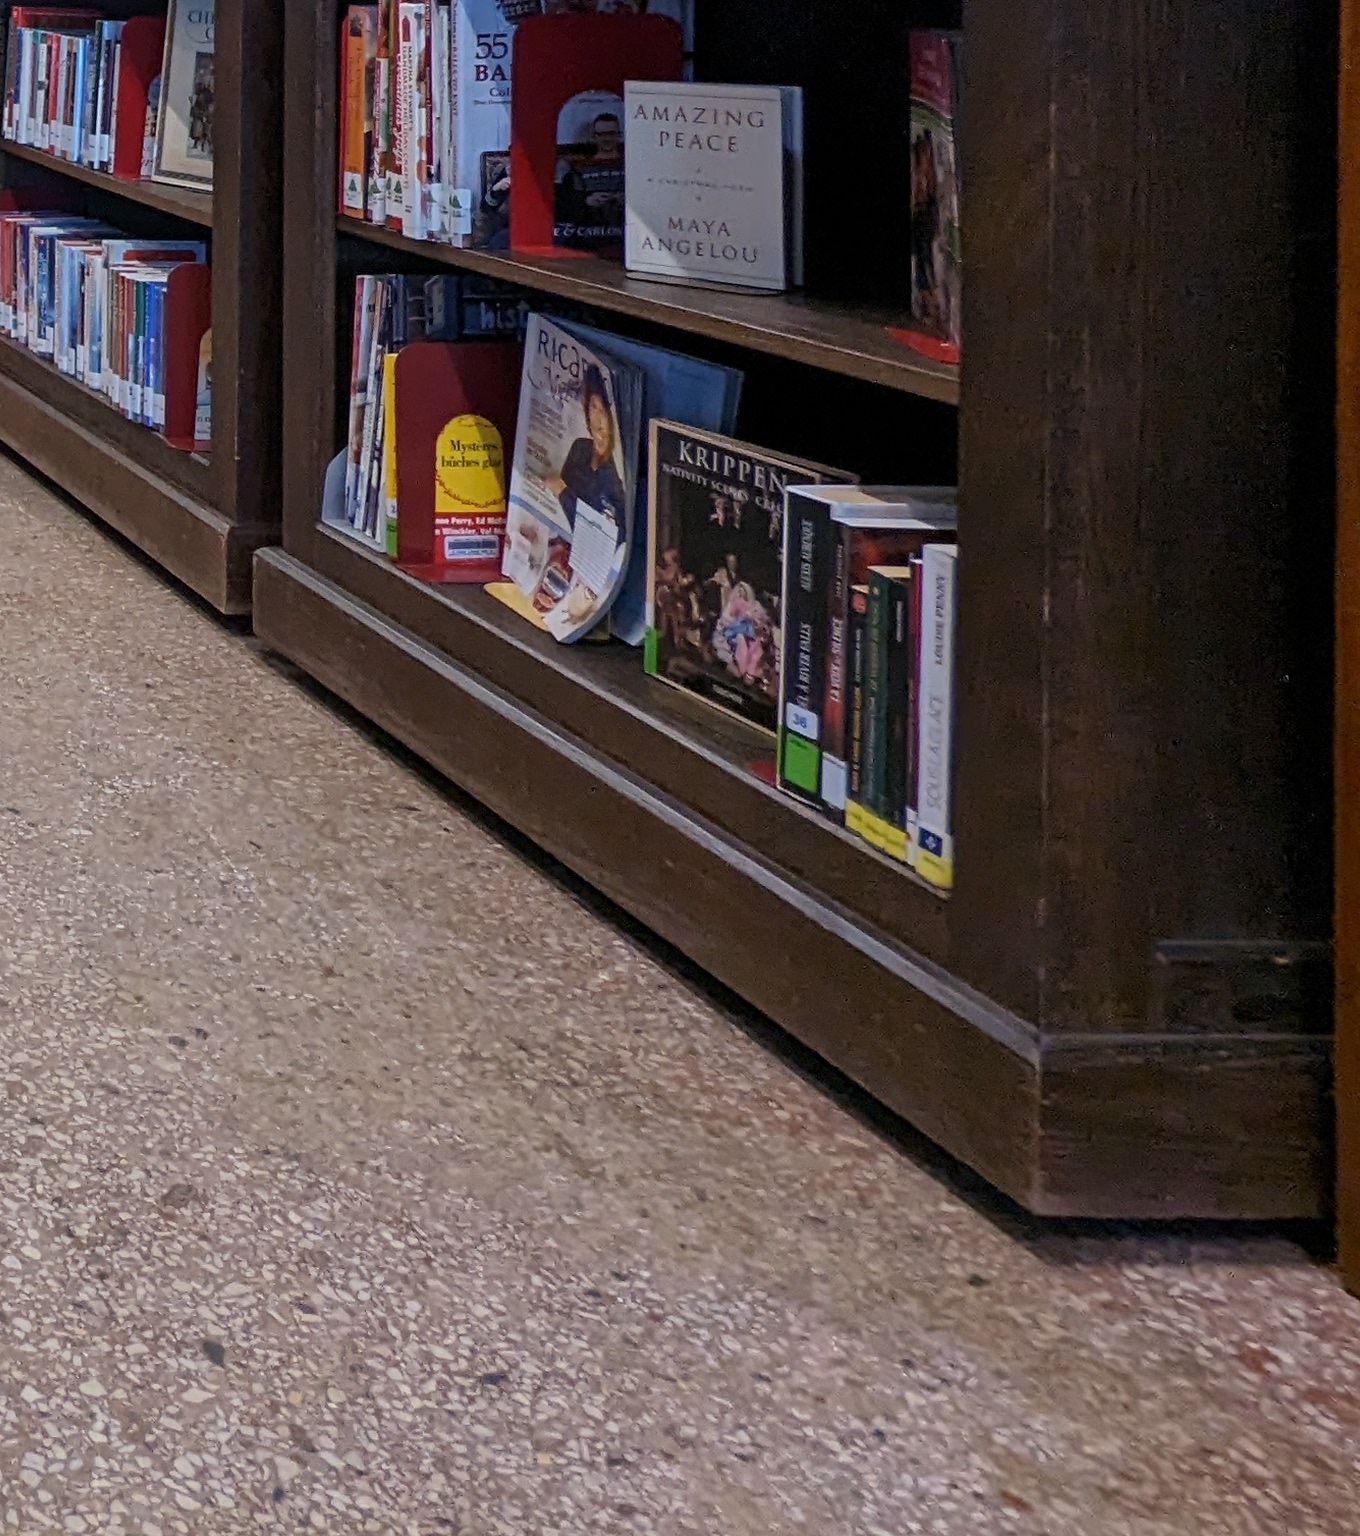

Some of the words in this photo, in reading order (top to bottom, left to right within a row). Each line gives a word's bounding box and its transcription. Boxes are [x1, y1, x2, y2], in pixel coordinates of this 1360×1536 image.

[474, 32, 509, 60] 55
[633, 103, 765, 128] AMAZING
[658, 130, 739, 153] PEACE
[668, 216, 732, 237] MAYA
[641, 236, 759, 264] ANGELOU
[679, 440, 788, 494] KRIPPEN
[934, 574, 947, 619] PENNY
